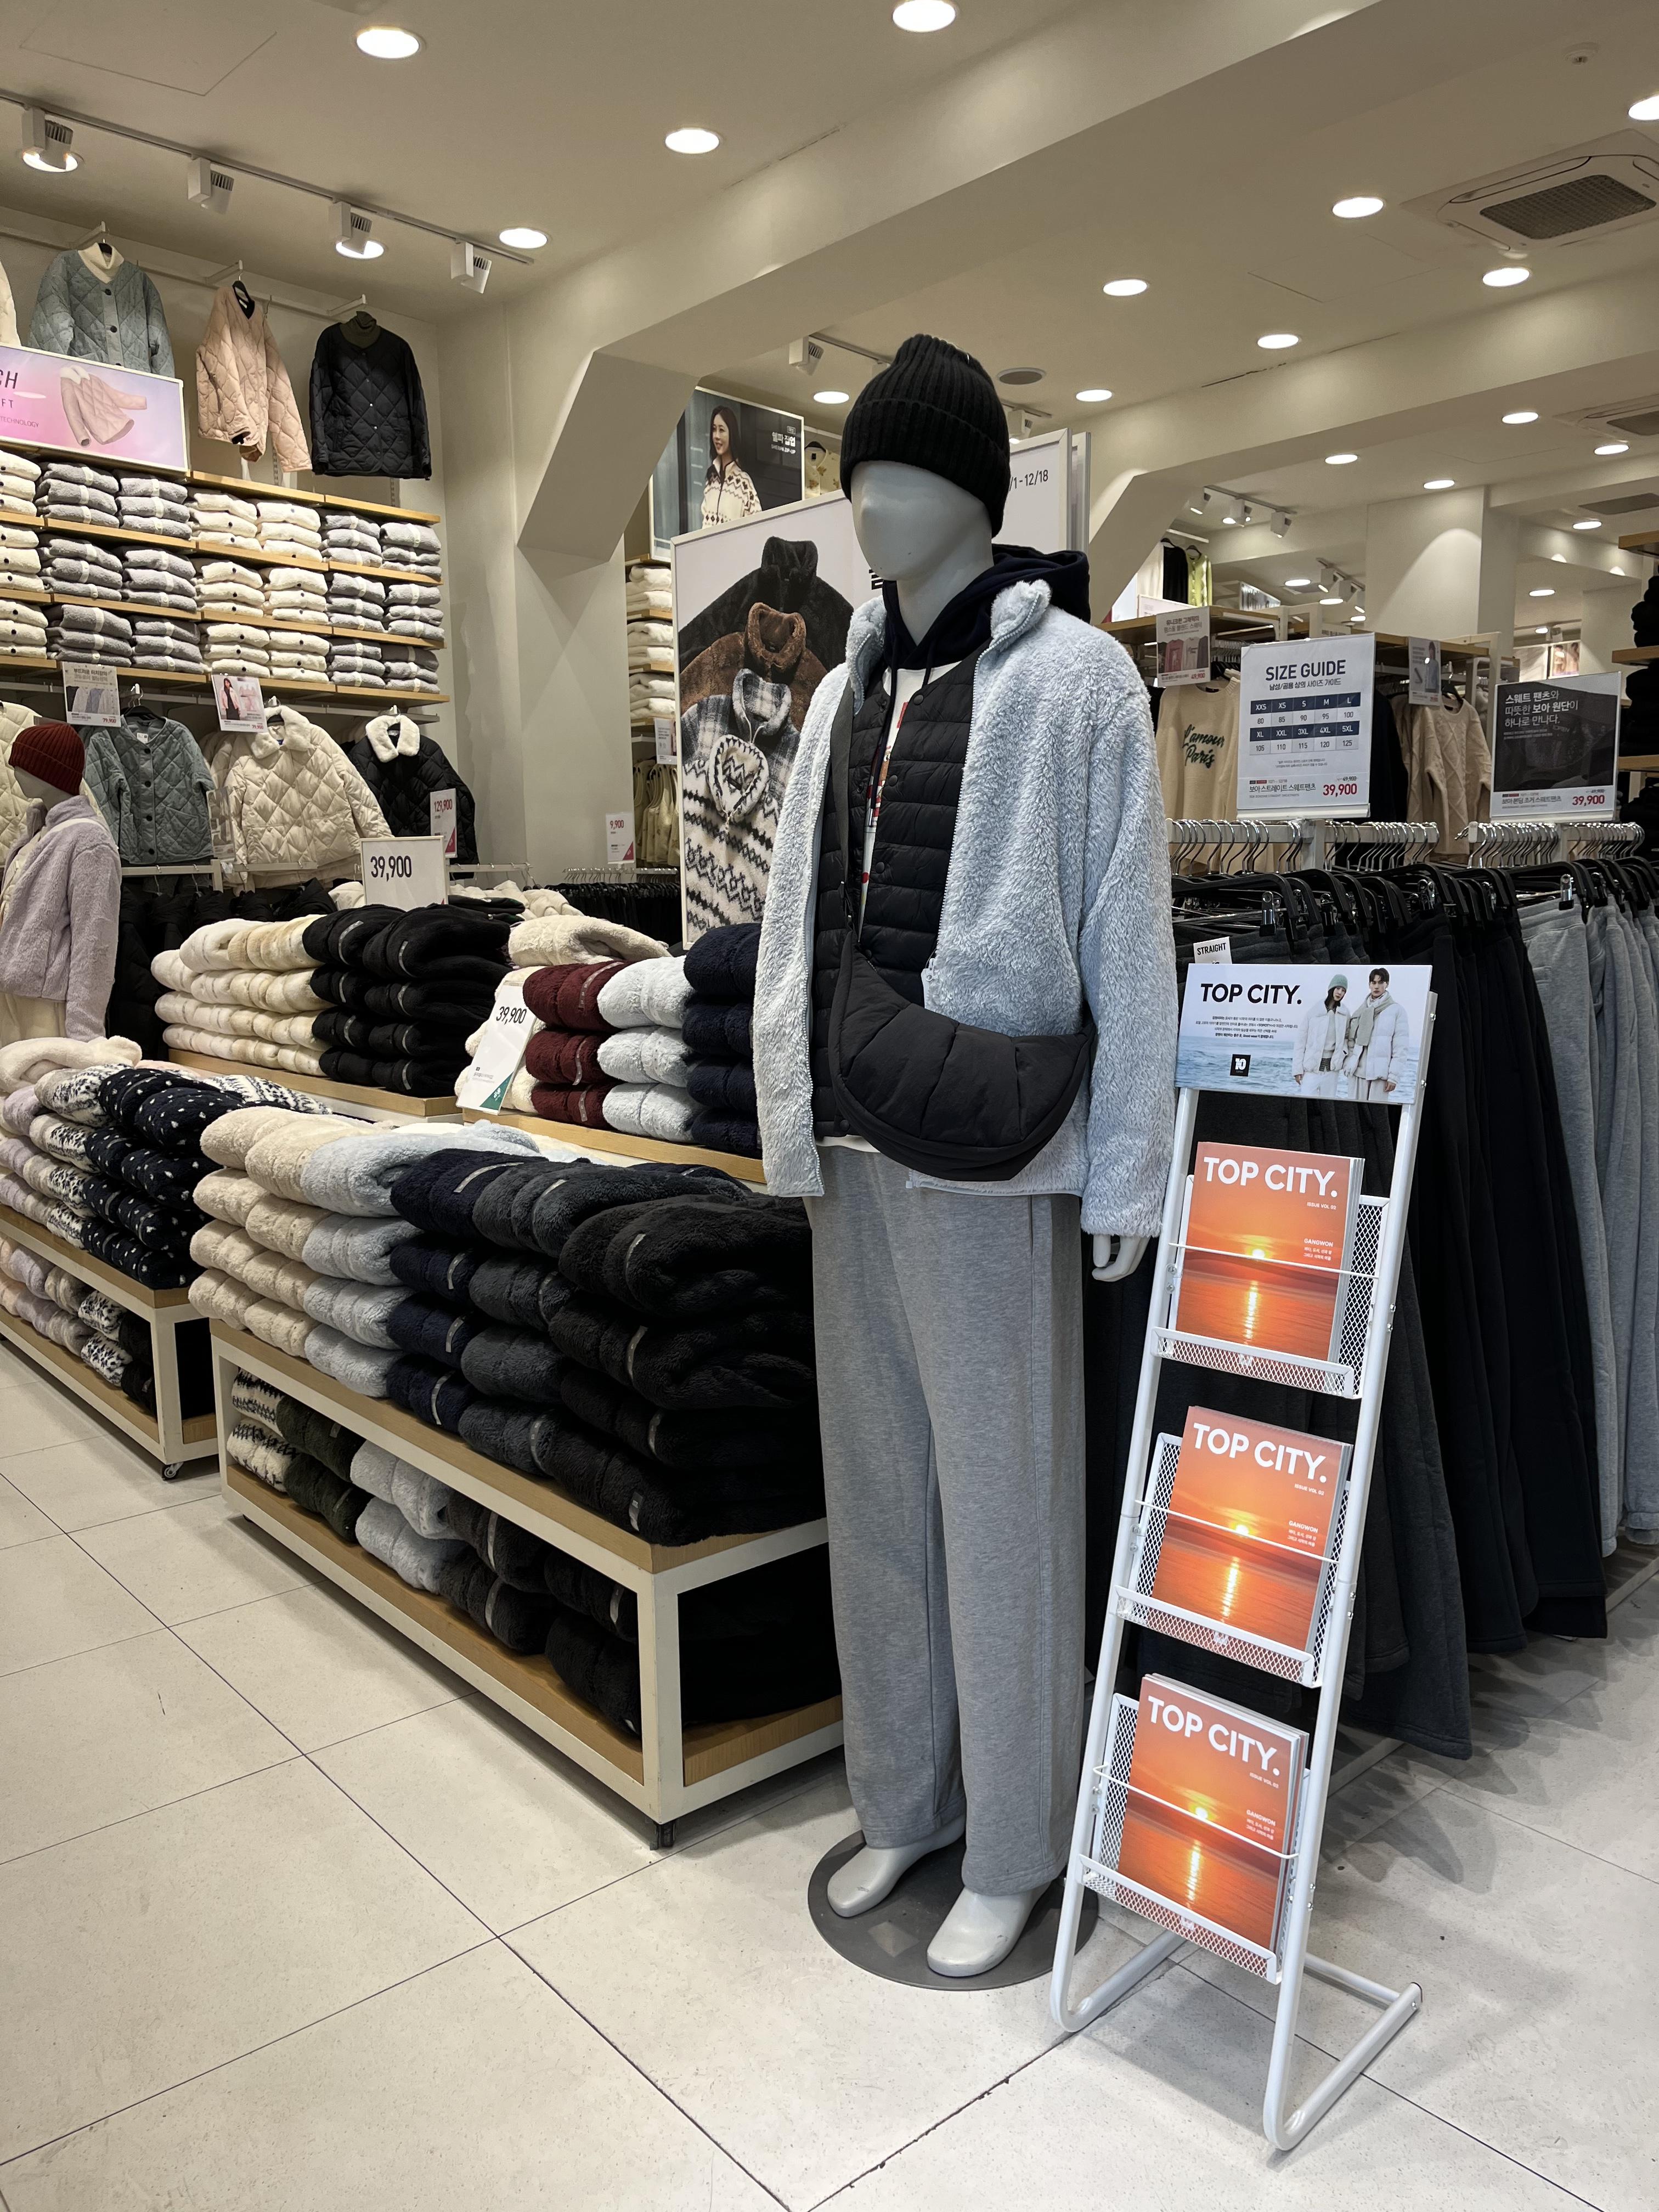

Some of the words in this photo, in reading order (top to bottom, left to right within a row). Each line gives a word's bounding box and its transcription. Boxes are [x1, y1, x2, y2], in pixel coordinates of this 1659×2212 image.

[1024, 469, 1048, 487] 12/18
[1265, 664, 1297, 681] SIZE
[1301, 659, 1346, 678] GUIDE
[1269, 682, 1294, 691] 남성/공용
[1505, 693, 1531, 704] 스웨트
[1533, 690, 1559, 702] 팬츠와
[1505, 704, 1531, 716] 따뜻한
[1532, 703, 1550, 713] 보아
[1552, 700, 1578, 712] 원단이
[1505, 716, 1530, 728] 하나로
[1532, 714, 1560, 726] 만나다.
[1185, 744, 1215, 769] Paris
[1323, 783, 1357, 797] 39,900
[434, 798, 453, 812] 129,900
[1572, 794, 1605, 806] 39,900
[610, 820, 624, 830] 9,900
[370, 855, 411, 882] 39,900
[1197, 943, 1226, 956] STRAIGHT
[1200, 983, 1243, 1002] TOP
[1247, 984, 1302, 1005] CITY.
[496, 1006, 527, 1025] 39,900
[1203, 1156, 1259, 1186] TOP
[1265, 1164, 1338, 1198] CITY.
[1304, 1238, 1334, 1248] GANGWON
[1193, 1422, 1249, 1458] TOP
[1254, 1440, 1327, 1483] CITY.
[1289, 1520, 1318, 1533] GANGWON
[1148, 1695, 1203, 1737] TOP
[1208, 1723, 1280, 1776] CITY.
[1246, 1809, 1276, 1826] GANGWON
